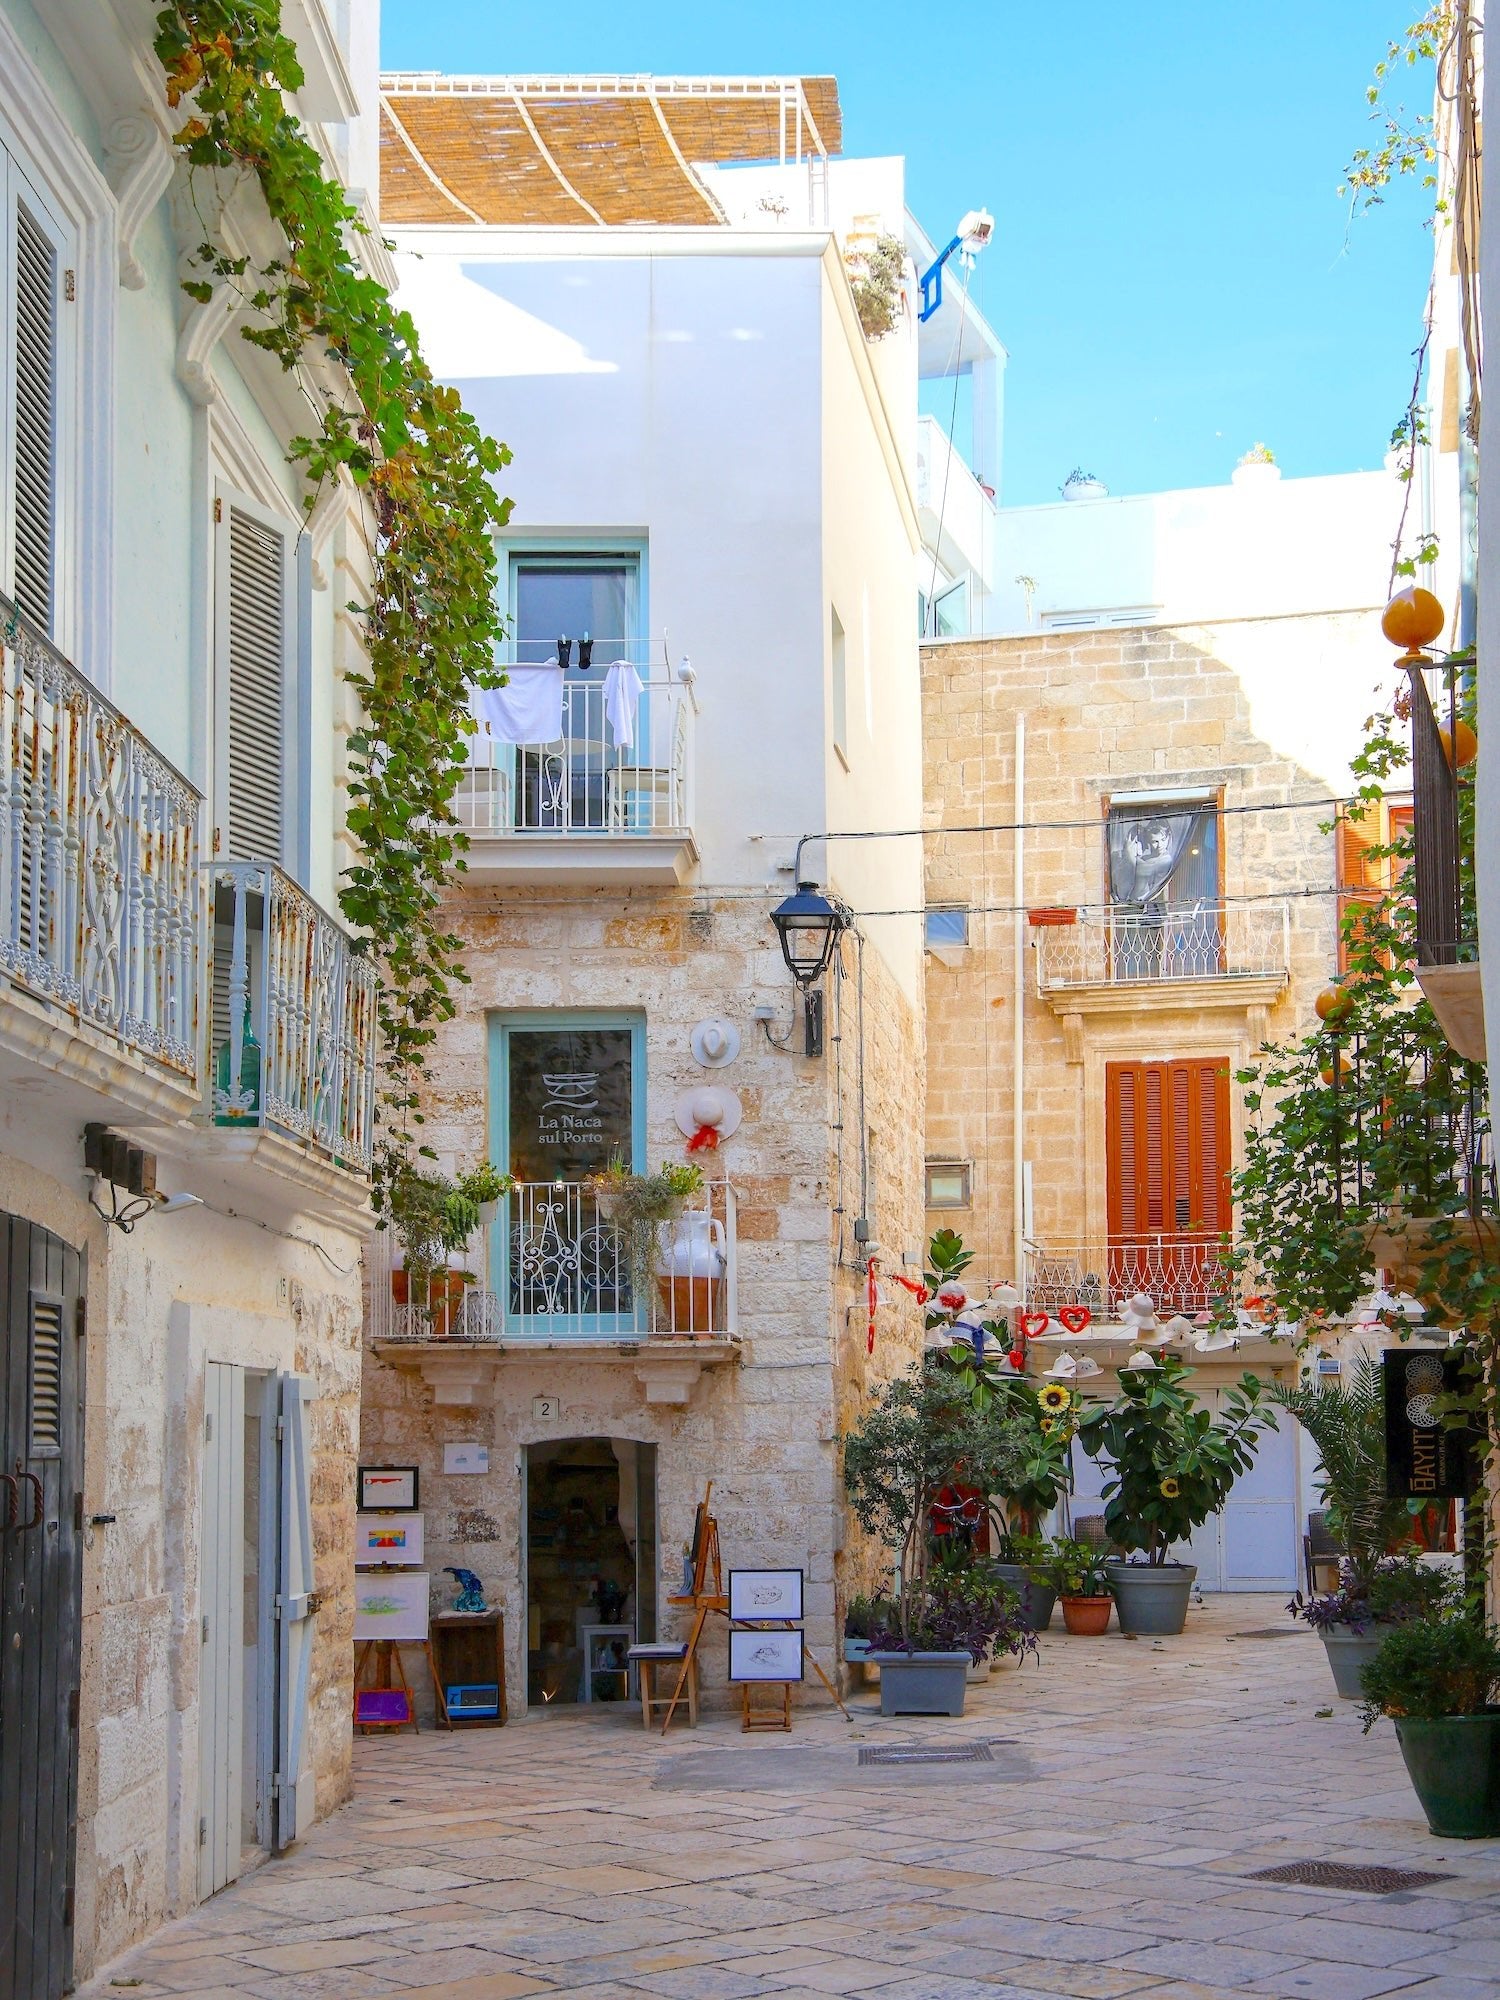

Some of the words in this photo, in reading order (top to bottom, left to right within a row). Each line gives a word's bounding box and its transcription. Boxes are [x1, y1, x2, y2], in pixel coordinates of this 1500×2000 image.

[538, 1115, 559, 1129] La
[561, 1114, 602, 1128] Naca
[538, 1130, 560, 1144] sul
[562, 1131, 603, 1143] Porto
[541, 1402, 550, 1416] 2
[1410, 1428, 1436, 1491] BAYIT
